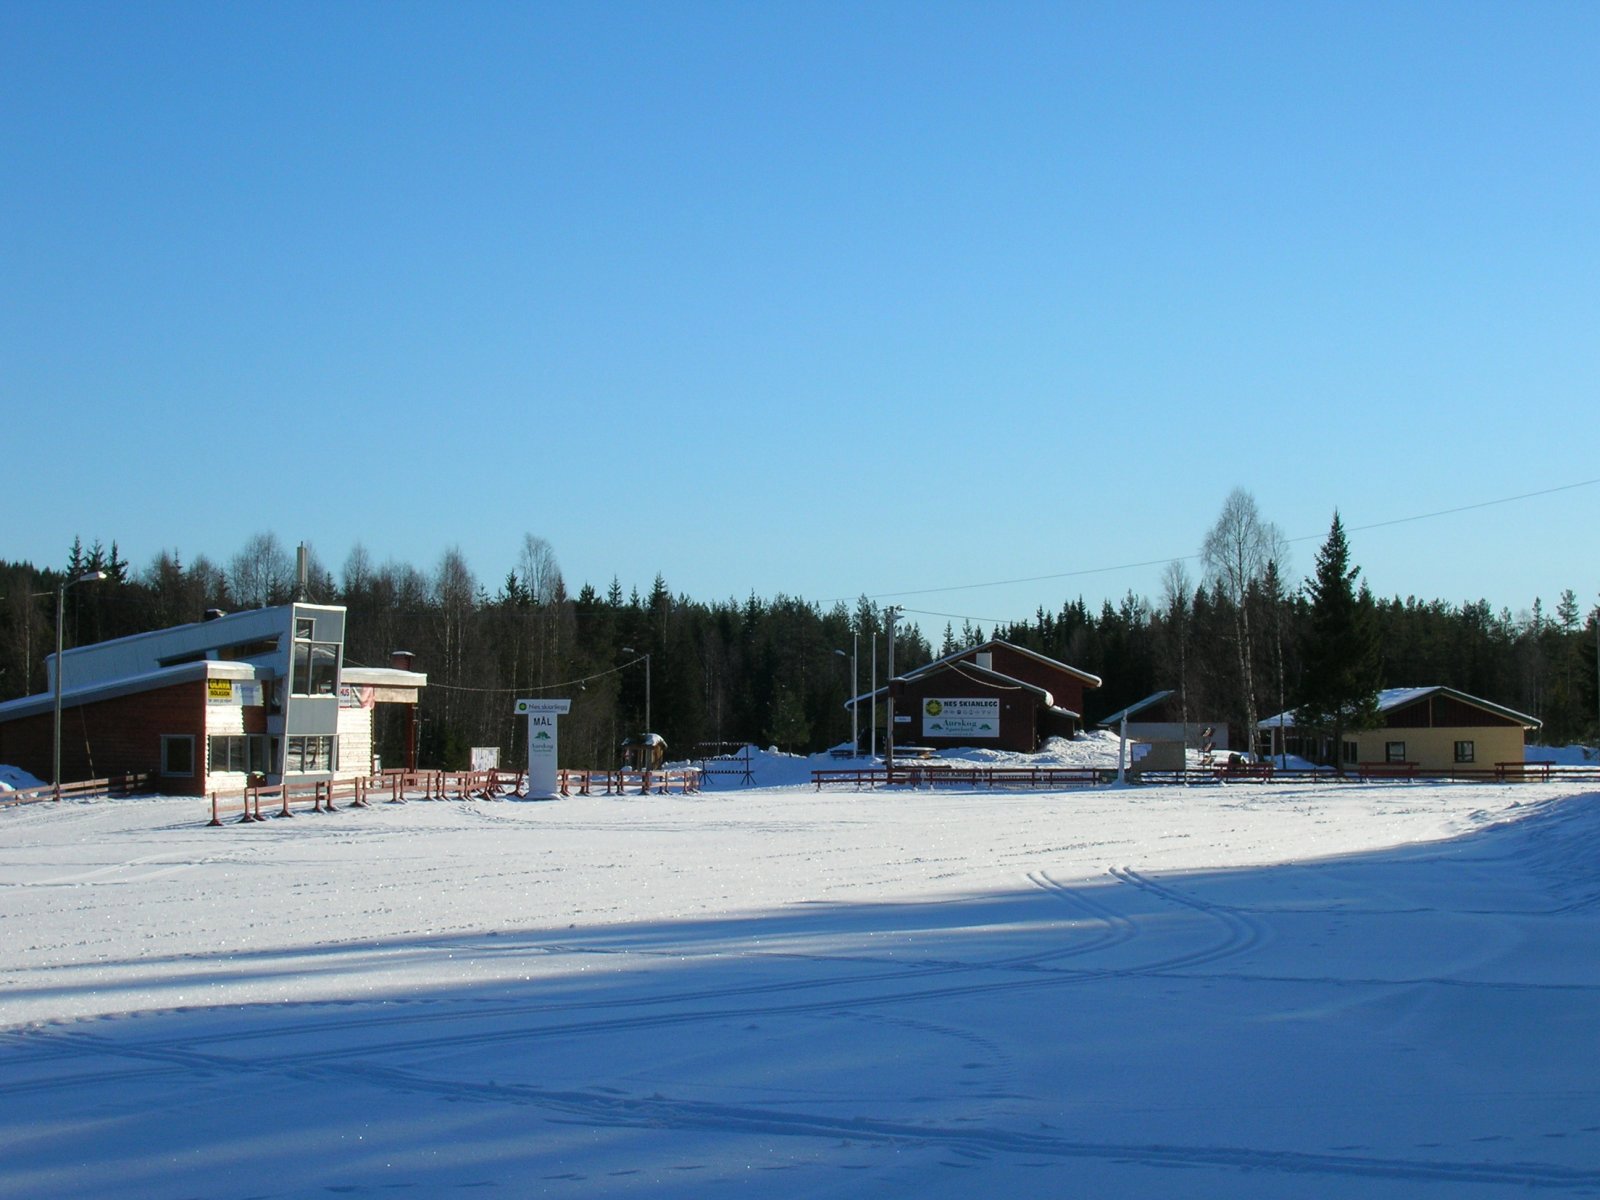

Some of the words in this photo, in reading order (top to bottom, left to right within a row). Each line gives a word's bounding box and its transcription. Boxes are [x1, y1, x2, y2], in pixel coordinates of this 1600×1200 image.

[209, 680, 230, 689] GLAVA
[533, 716, 552, 726] MÅL
[943, 719, 976, 727] Aurskog
